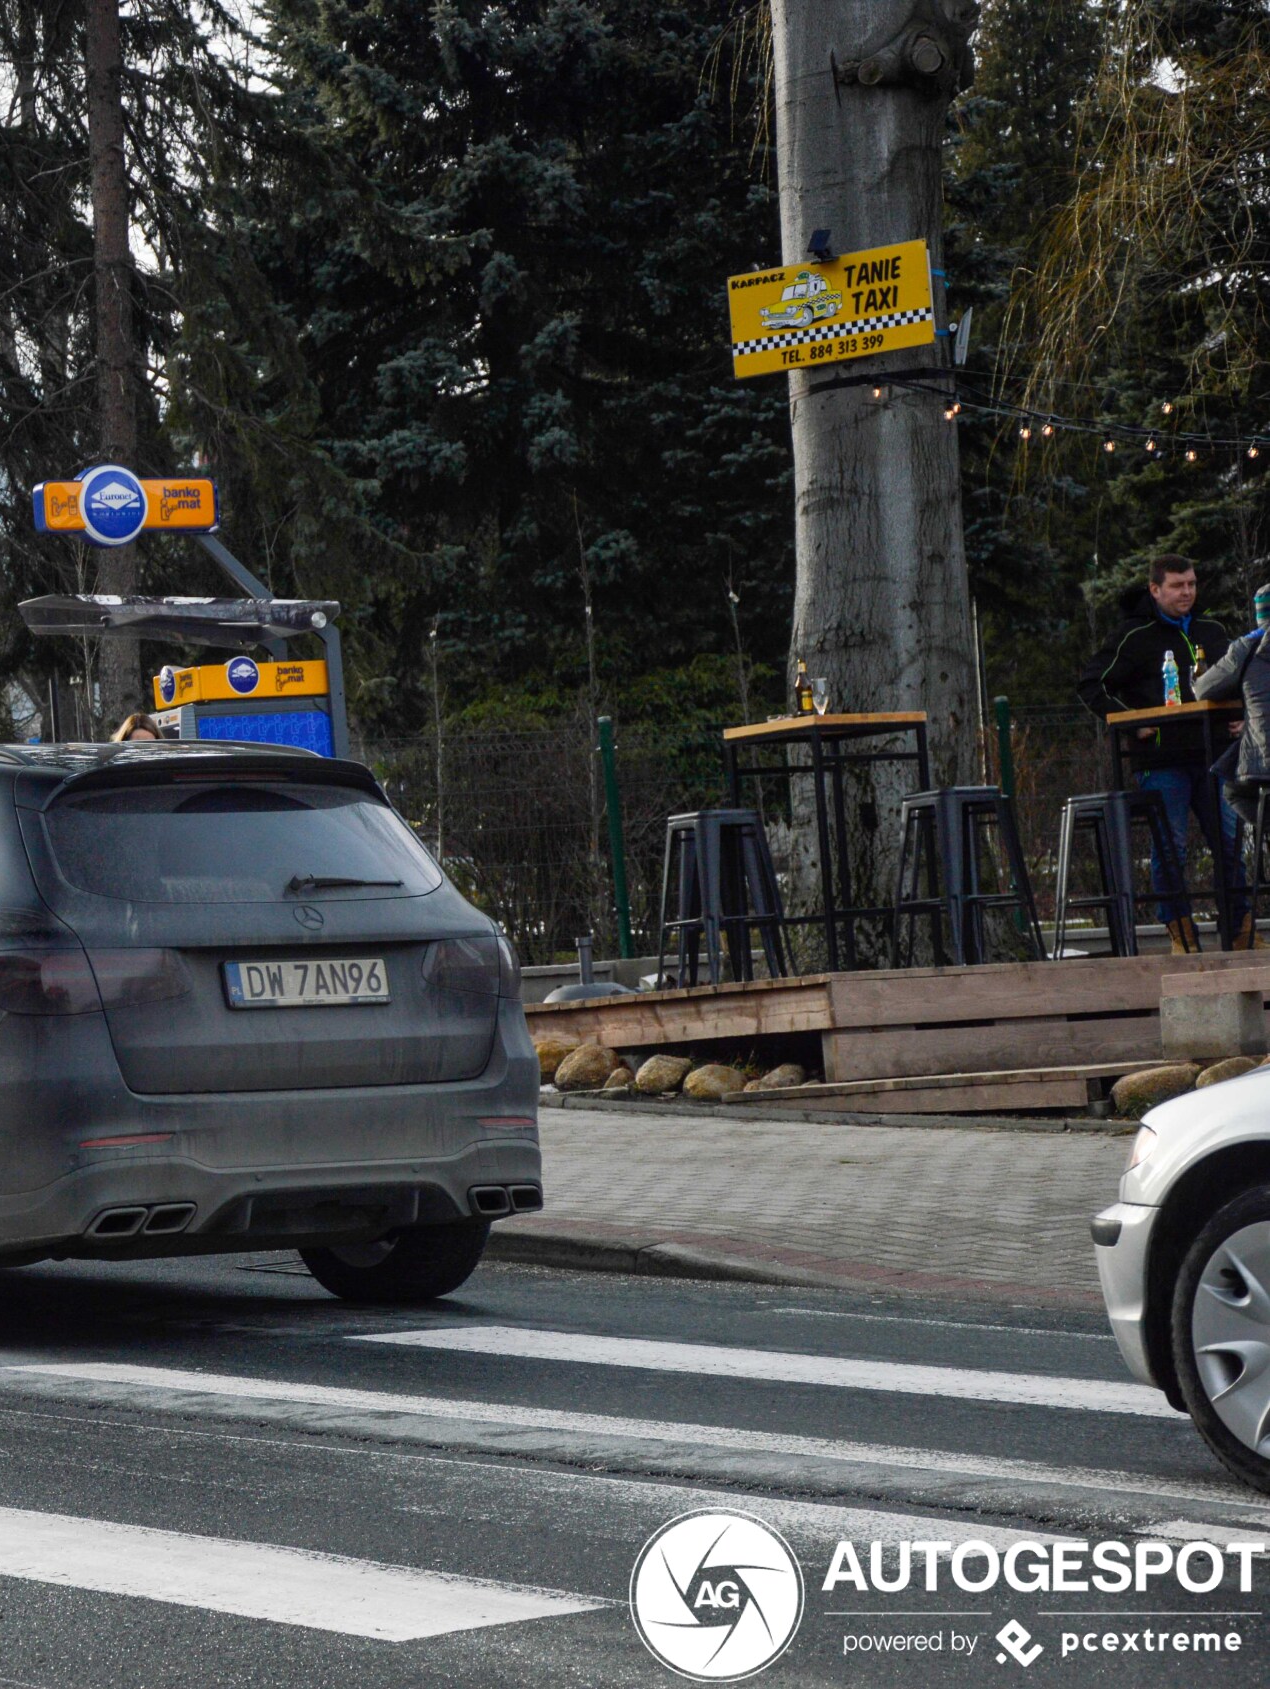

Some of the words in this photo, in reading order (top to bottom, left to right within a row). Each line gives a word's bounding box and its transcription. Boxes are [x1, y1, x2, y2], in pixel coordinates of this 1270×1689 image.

[844, 255, 902, 288] TANIE
[731, 272, 786, 290] KARPACZ
[851, 285, 898, 315] TAXI
[781, 349, 806, 365] TEL.
[810, 343, 833, 360] 884
[838, 338, 857, 355] 313
[861, 334, 884, 351] 399
[99, 492, 132, 501] Euronet
[163, 486, 200, 499] banko
[177, 498, 201, 509] mat
[277, 664, 304, 675] banko
[287, 674, 304, 682] mat
[246, 964, 284, 998] DW
[293, 961, 382, 996] 7AN96
